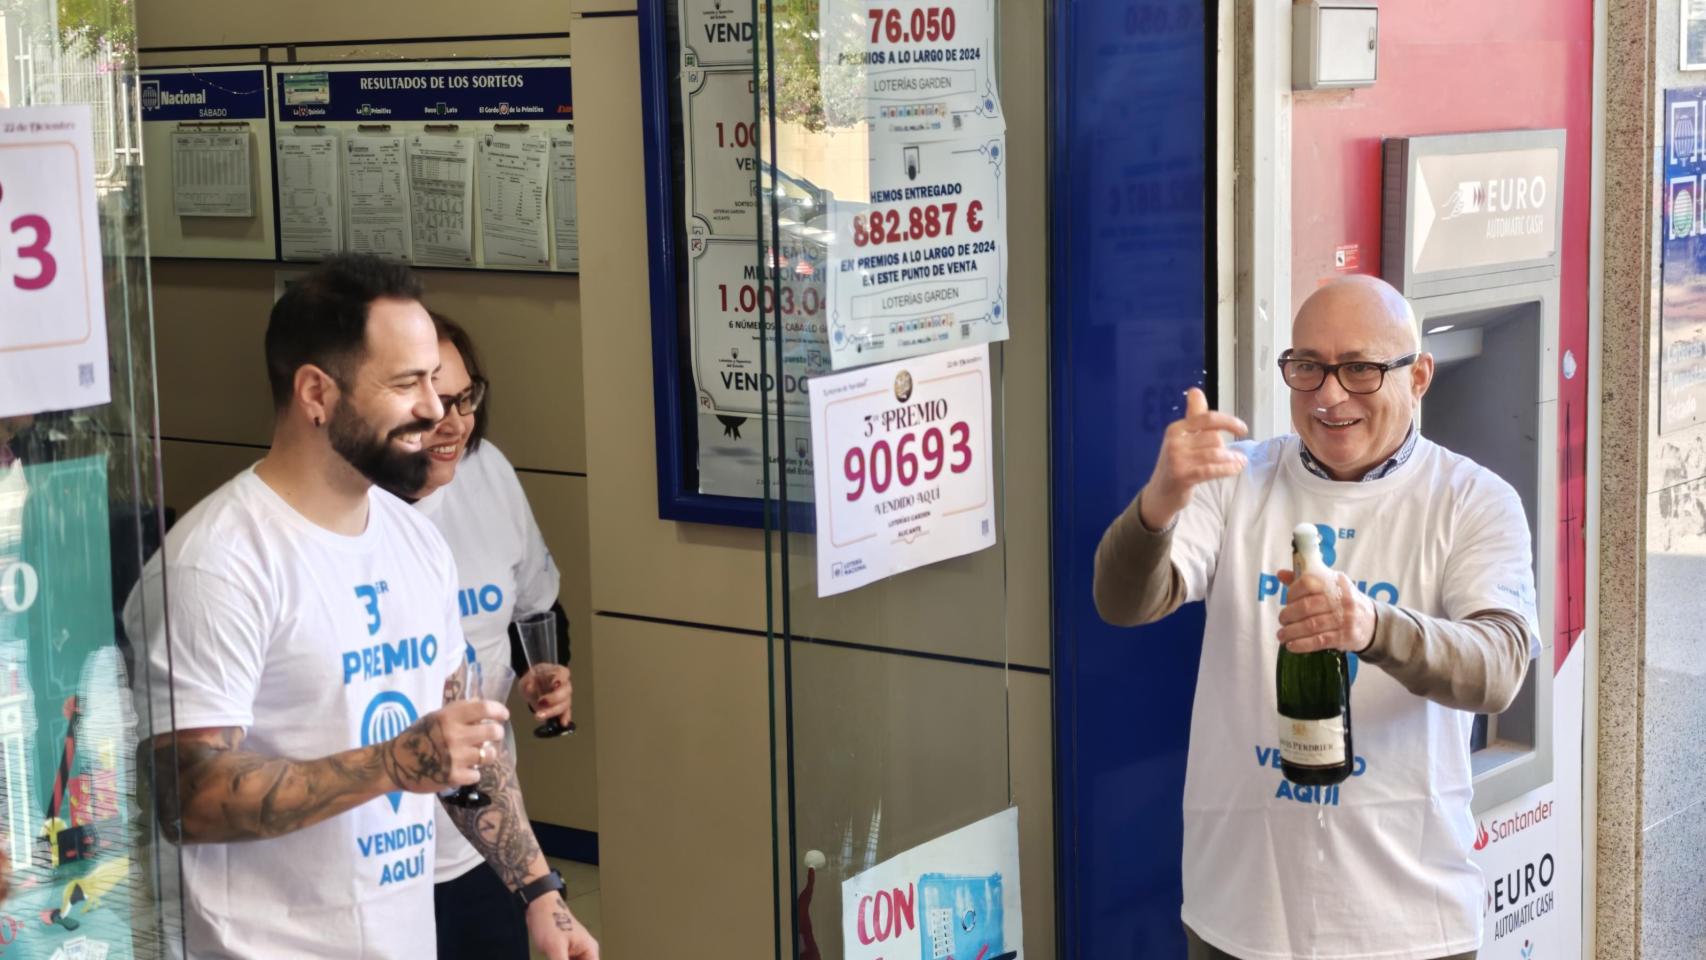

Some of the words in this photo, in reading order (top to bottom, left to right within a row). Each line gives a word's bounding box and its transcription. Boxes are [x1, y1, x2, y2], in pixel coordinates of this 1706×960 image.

[868, 7, 956, 44] 76.050
[888, 51, 896, 63] A
[898, 51, 911, 63] LO
[914, 50, 943, 62] LARGO
[946, 49, 957, 60] DE
[959, 48, 980, 60] 2024
[160, 88, 207, 105] Nacional
[360, 76, 427, 90] RESULTADOS
[430, 76, 445, 89] DE
[448, 76, 469, 88] LOS
[472, 75, 524, 88] SORTEOS
[874, 77, 917, 92] LOTERÍAS
[919, 77, 952, 90] GARDEN
[870, 190, 903, 204] HEMOS
[905, 183, 962, 200] ENTREGADO
[1487, 175, 1546, 212] EURO
[853, 202, 958, 248] 882.887
[967, 199, 984, 233] €
[1486, 216, 1525, 239] AUTOMATIC
[1526, 214, 1545, 235] CASH
[840, 259, 856, 272] EN
[858, 253, 899, 269] PREMIOS
[902, 253, 908, 265] A
[910, 250, 921, 263] LO
[924, 247, 955, 261] LARGO
[958, 244, 970, 256] DE
[973, 240, 996, 254] 2024
[877, 270, 899, 285] ESTE
[902, 266, 930, 281] PUNTO
[933, 263, 945, 277] DE
[947, 259, 977, 274] VENTA
[882, 293, 923, 310] LOTERÍAS
[924, 287, 959, 303] GARDEN
[882, 398, 948, 432] PREMIO
[844, 420, 972, 503] 90693
[874, 494, 915, 515] VENDIDO
[342, 633, 437, 685] PREMIO
[1491, 800, 1554, 844] Santander
[379, 847, 425, 887] AQUÍ
[1494, 852, 1555, 913] EURO
[858, 882, 915, 946] CON
[1494, 900, 1535, 941] AUTOMATIC
[1535, 890, 1554, 918] CASH
